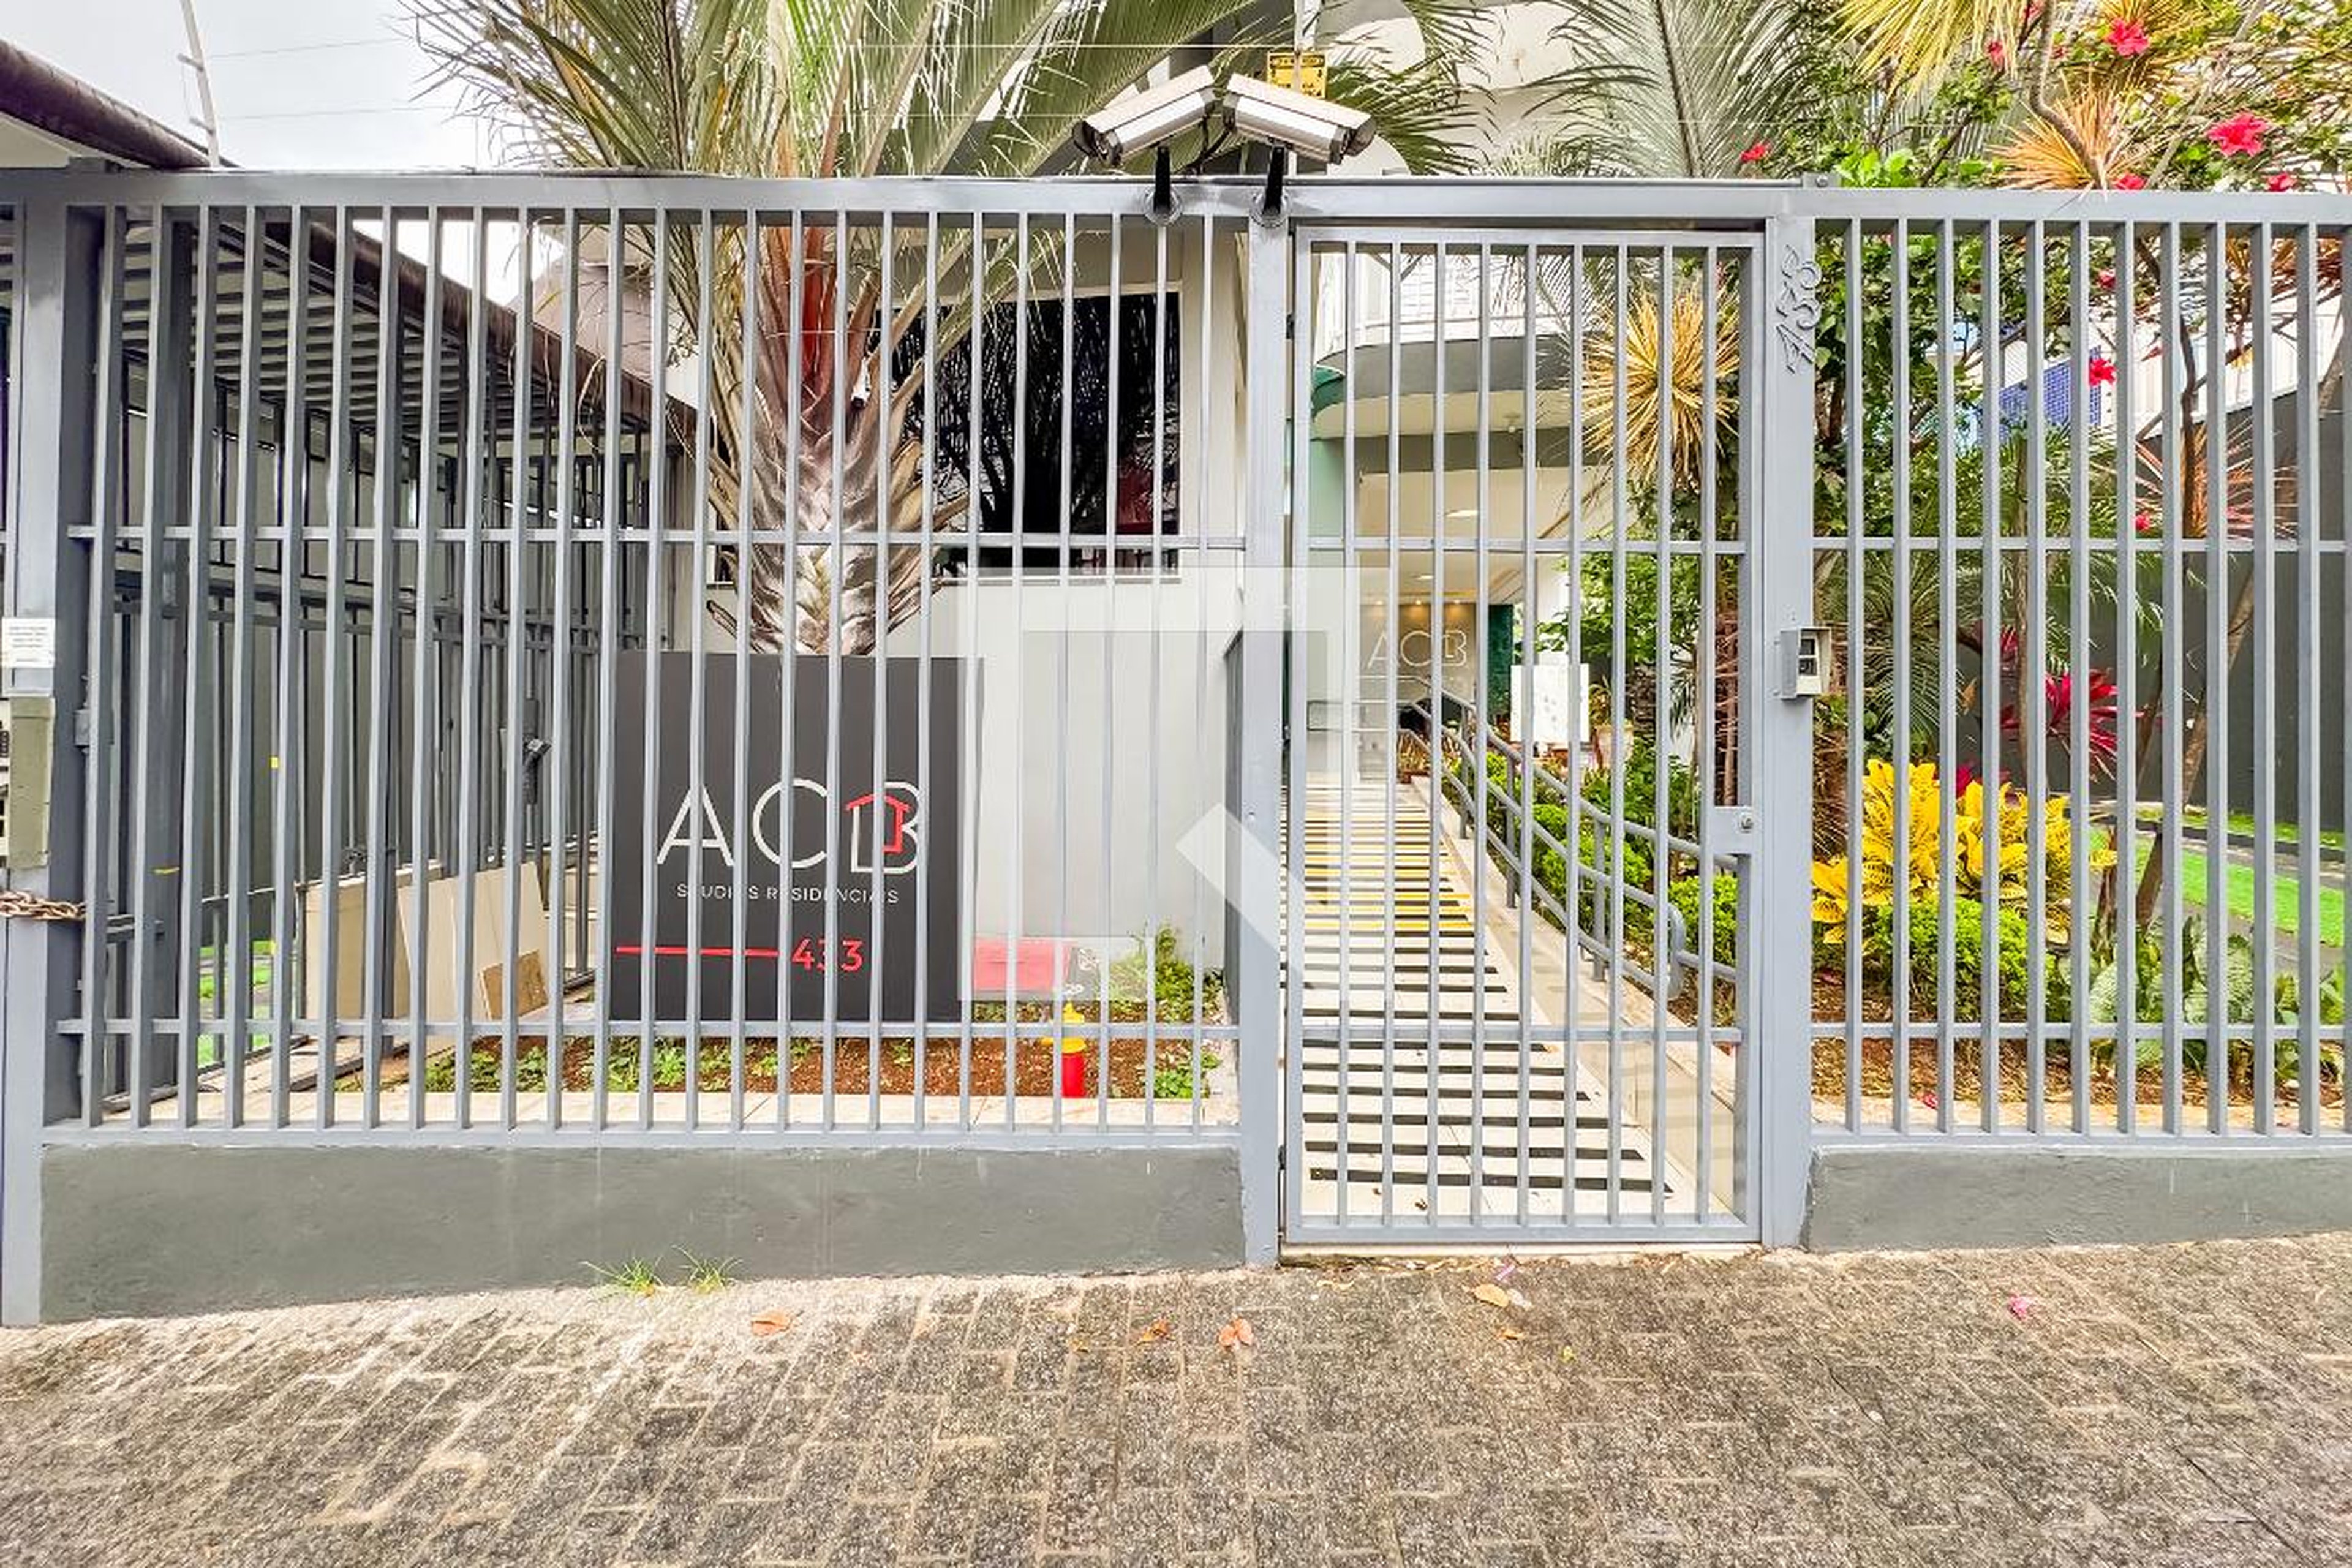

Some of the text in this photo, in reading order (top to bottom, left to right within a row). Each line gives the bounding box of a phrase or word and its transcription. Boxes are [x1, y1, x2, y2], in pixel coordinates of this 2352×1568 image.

[1367, 630, 1467, 669] ACB
[657, 778, 924, 874] ACB
[676, 883, 760, 900] SUDIS
